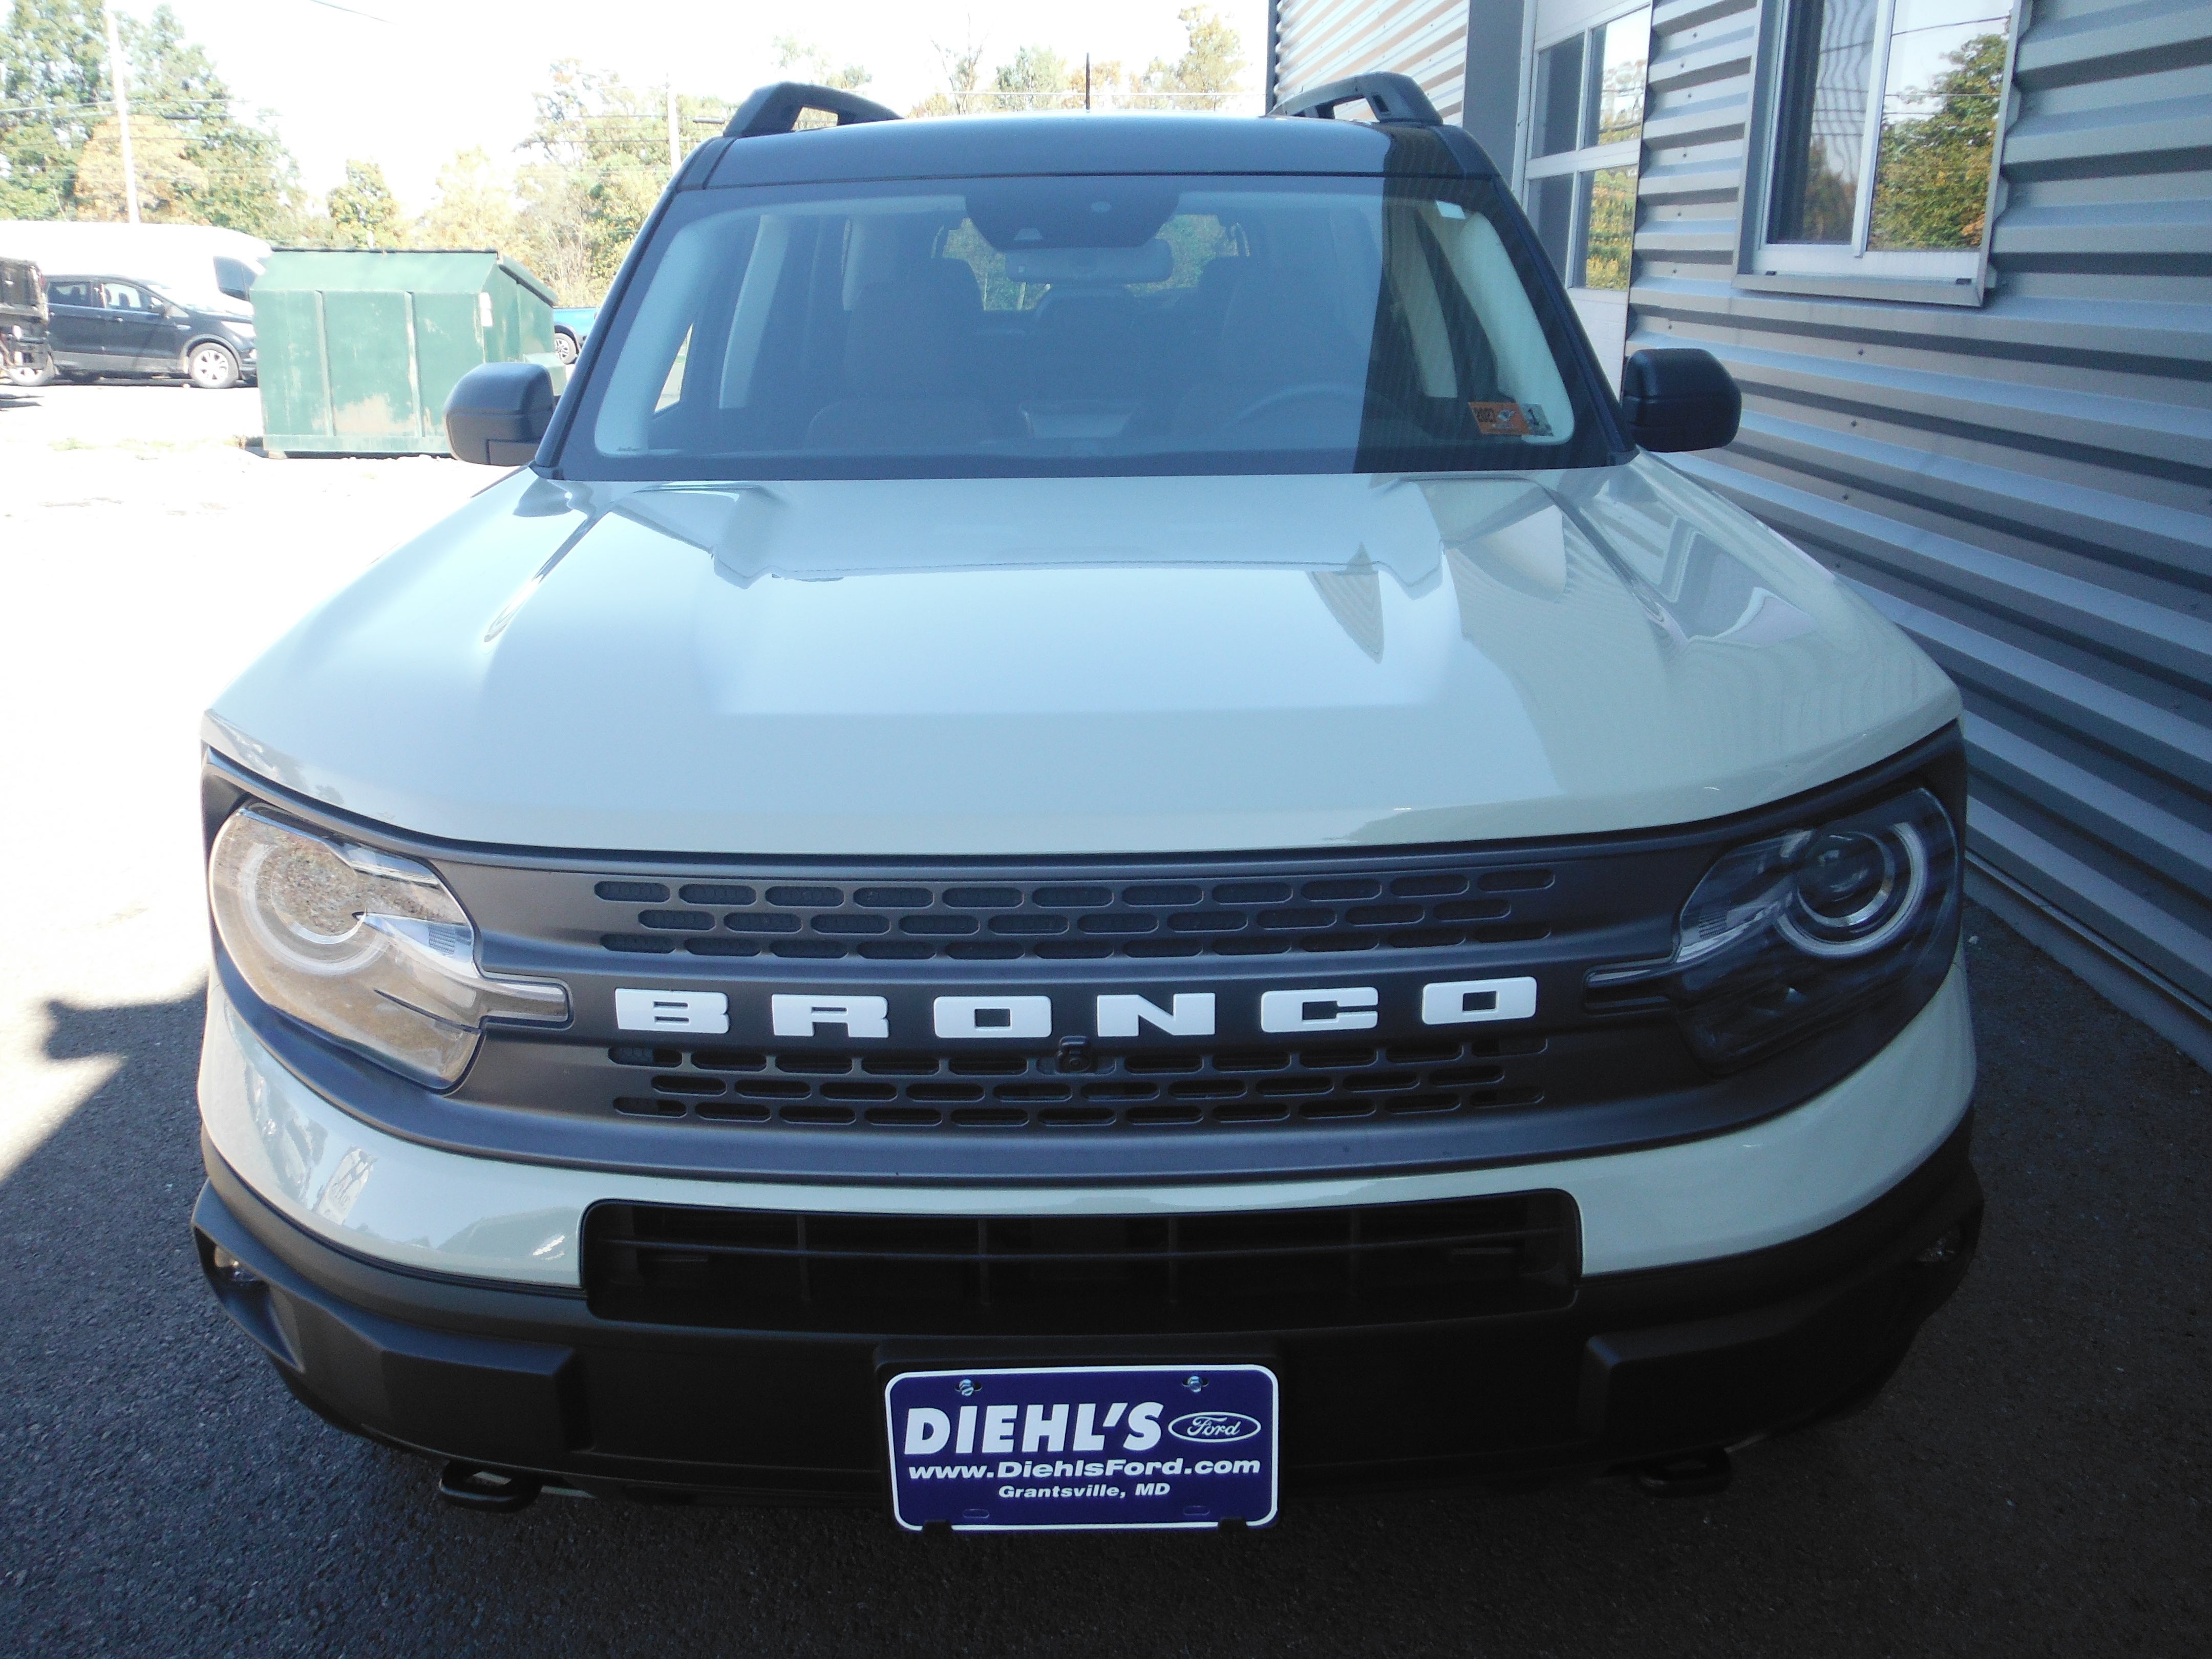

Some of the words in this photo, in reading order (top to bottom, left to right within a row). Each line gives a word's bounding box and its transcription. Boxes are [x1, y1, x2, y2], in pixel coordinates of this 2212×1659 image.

[614, 976, 1537, 1038] BRONCO
[904, 1401, 1164, 1455] DIEHL'S
[1187, 1416, 1242, 1436] Ford
[908, 1458, 1261, 1479] www.DiehlsFord.com
[998, 1484, 1126, 1498] Grantsville,
[1134, 1483, 1171, 1496] MD
